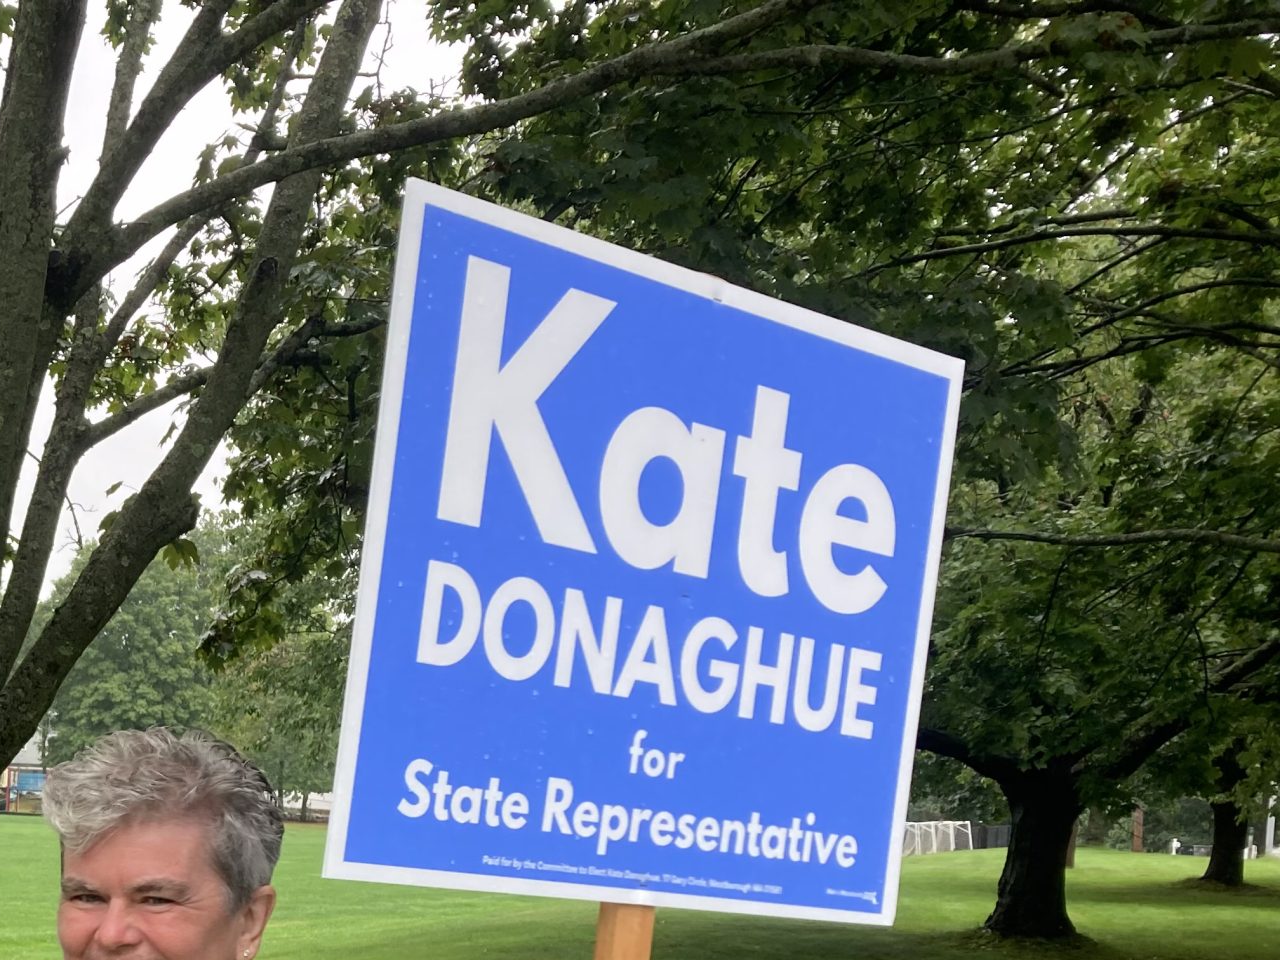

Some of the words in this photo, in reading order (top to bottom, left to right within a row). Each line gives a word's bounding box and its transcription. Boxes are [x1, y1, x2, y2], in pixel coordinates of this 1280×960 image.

[437, 254, 896, 615] Kate
[415, 559, 883, 740] DONAGHUE
[629, 729, 686, 780] for
[397, 758, 530, 830] State
[541, 776, 859, 869] Representative
[482, 855, 500, 866] Paid
[500, 857, 512, 867] for
[512, 858, 522, 871] by
[523, 860, 536, 869] the
[536, 861, 578, 874] Committee
[578, 866, 588, 875] to
[588, 866, 606, 877] Elect
